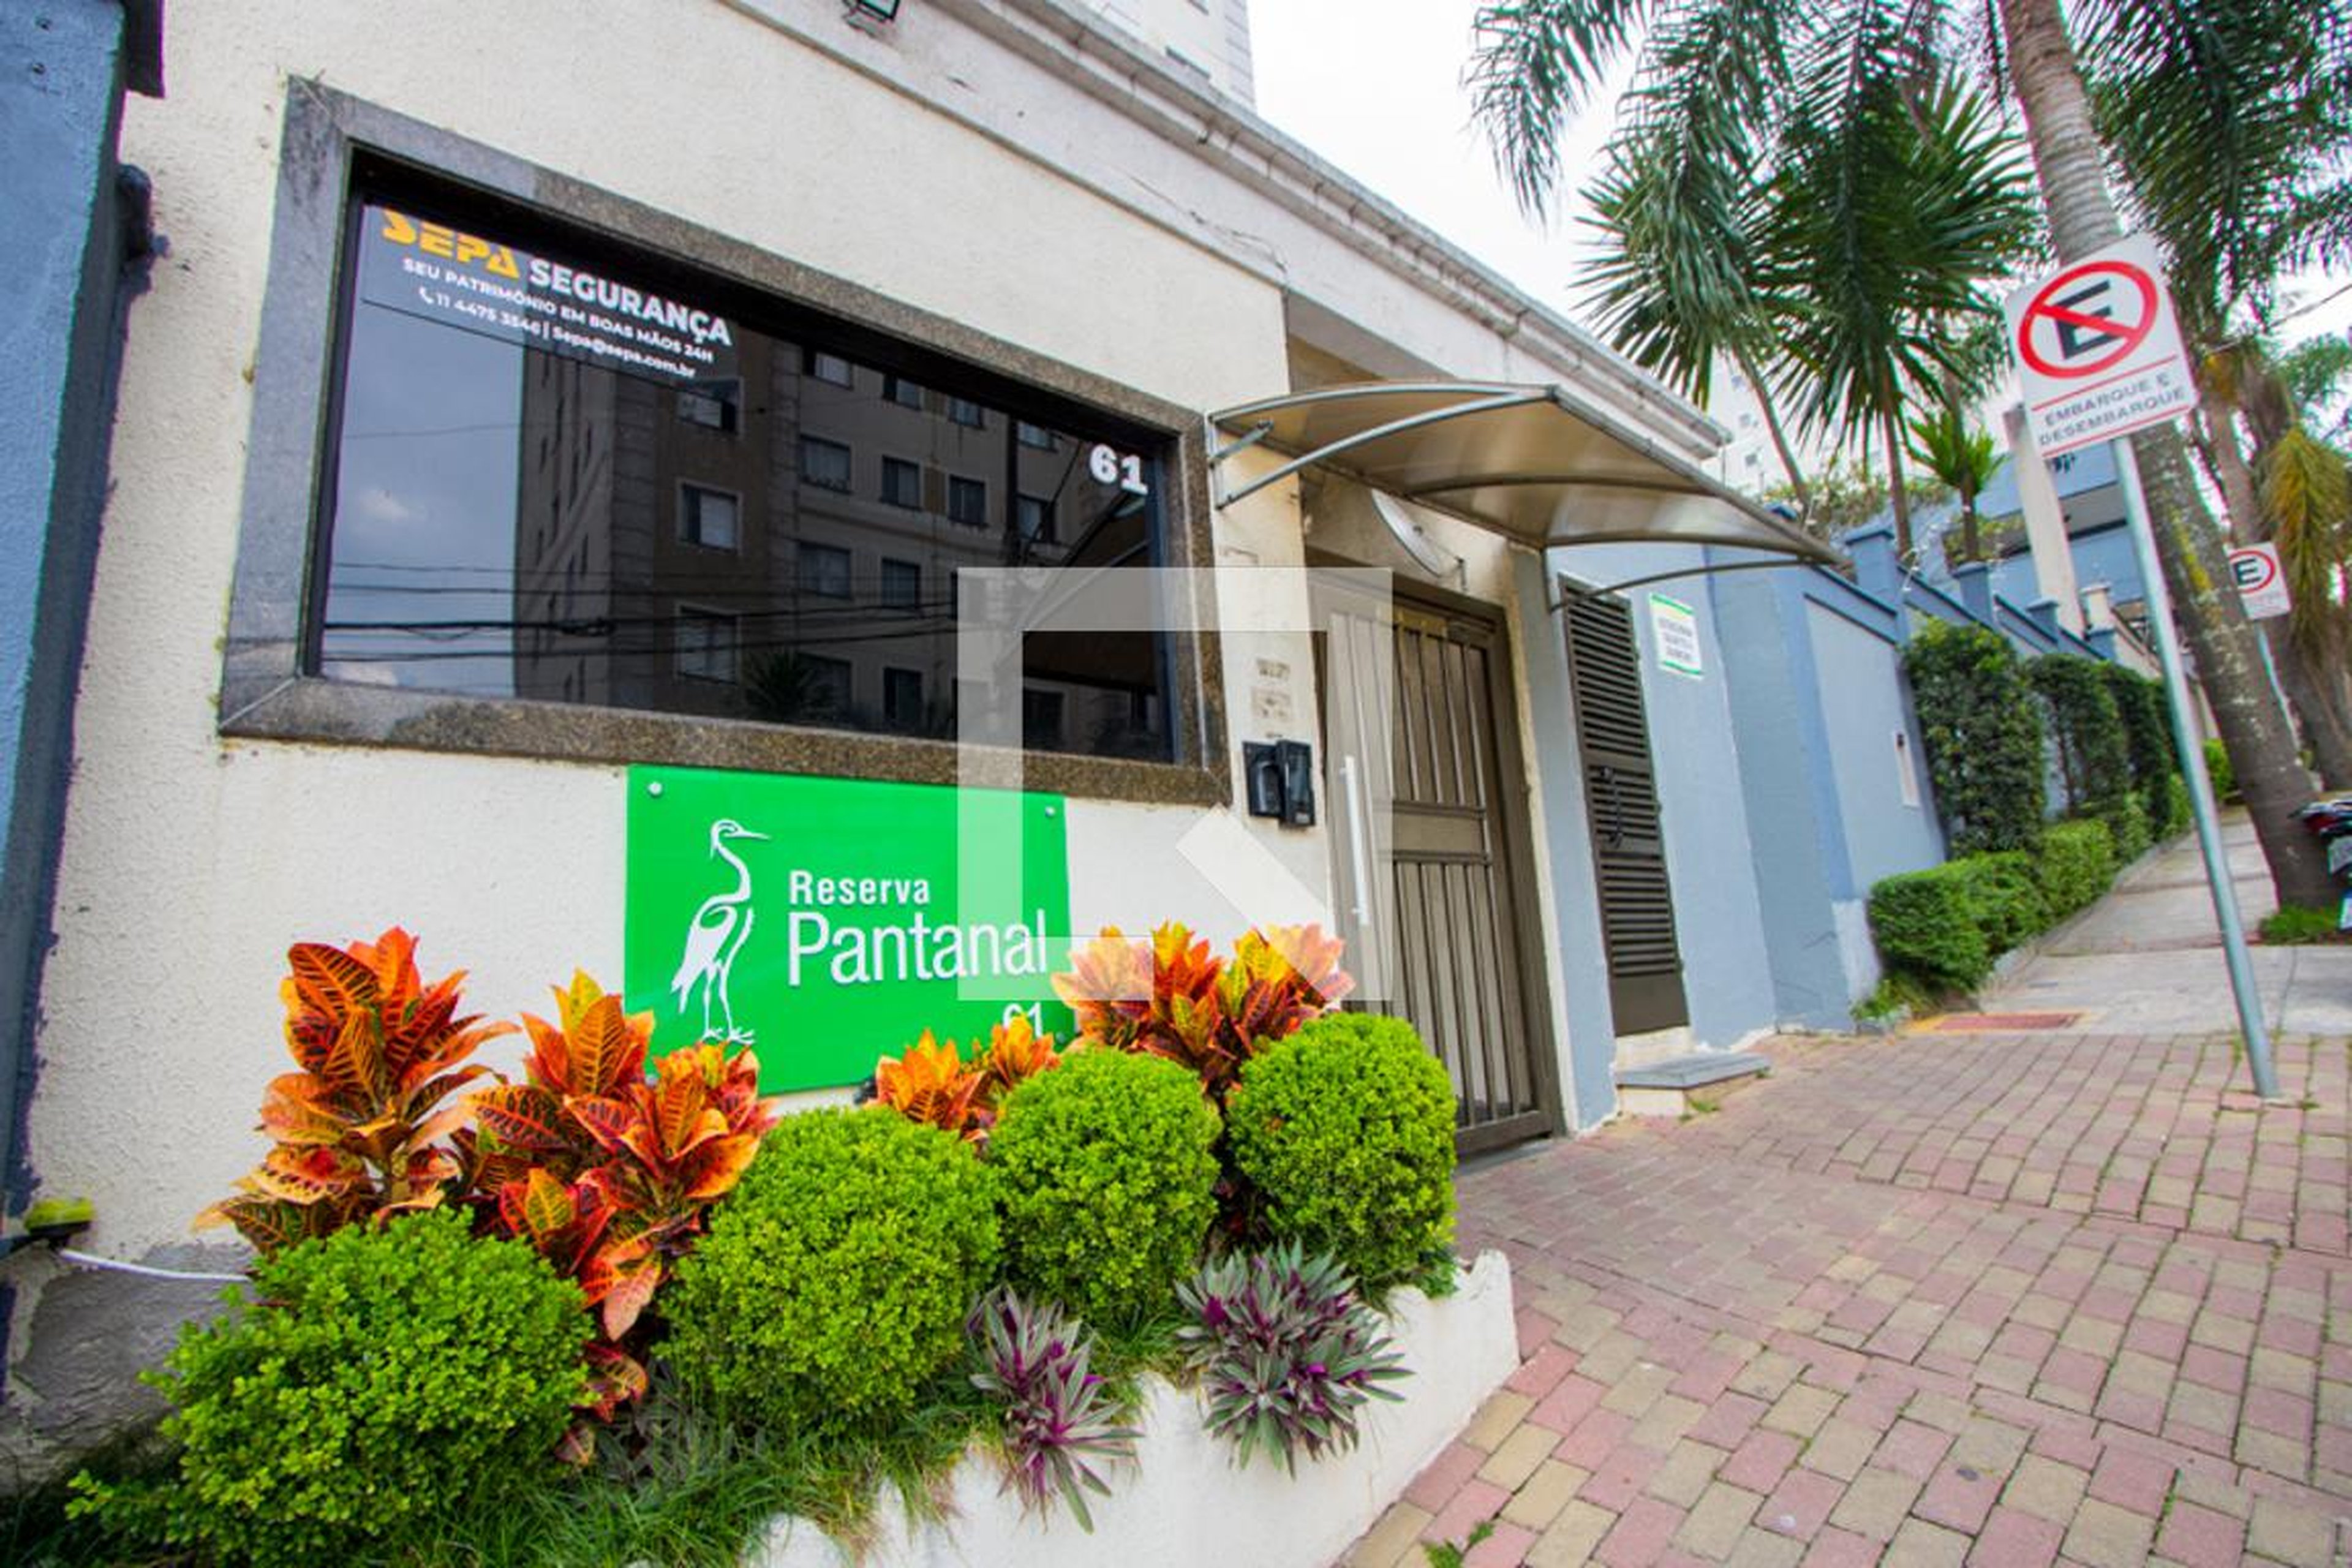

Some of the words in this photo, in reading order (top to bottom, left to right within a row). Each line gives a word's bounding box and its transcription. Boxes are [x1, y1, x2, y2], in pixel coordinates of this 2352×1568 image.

[383, 209, 519, 278] SEPA
[529, 258, 733, 346] SEGURANÇA
[402, 257, 440, 280] SEU
[445, 269, 557, 315] PATRIMÔNIO
[560, 304, 586, 325] EM
[589, 313, 634, 339] BOAS
[636, 330, 683, 355] MÃOS
[684, 342, 714, 363] 24H
[2052, 279, 2122, 360] E
[2039, 386, 2185, 446] DESEMBARQUE
[2044, 379, 2150, 427] EMBARQUE
[2156, 371, 2171, 387] E
[1090, 443, 1148, 495] 61
[2233, 557, 2262, 586] E
[789, 869, 930, 905] Reserva
[788, 908, 1047, 987] Pantanal
